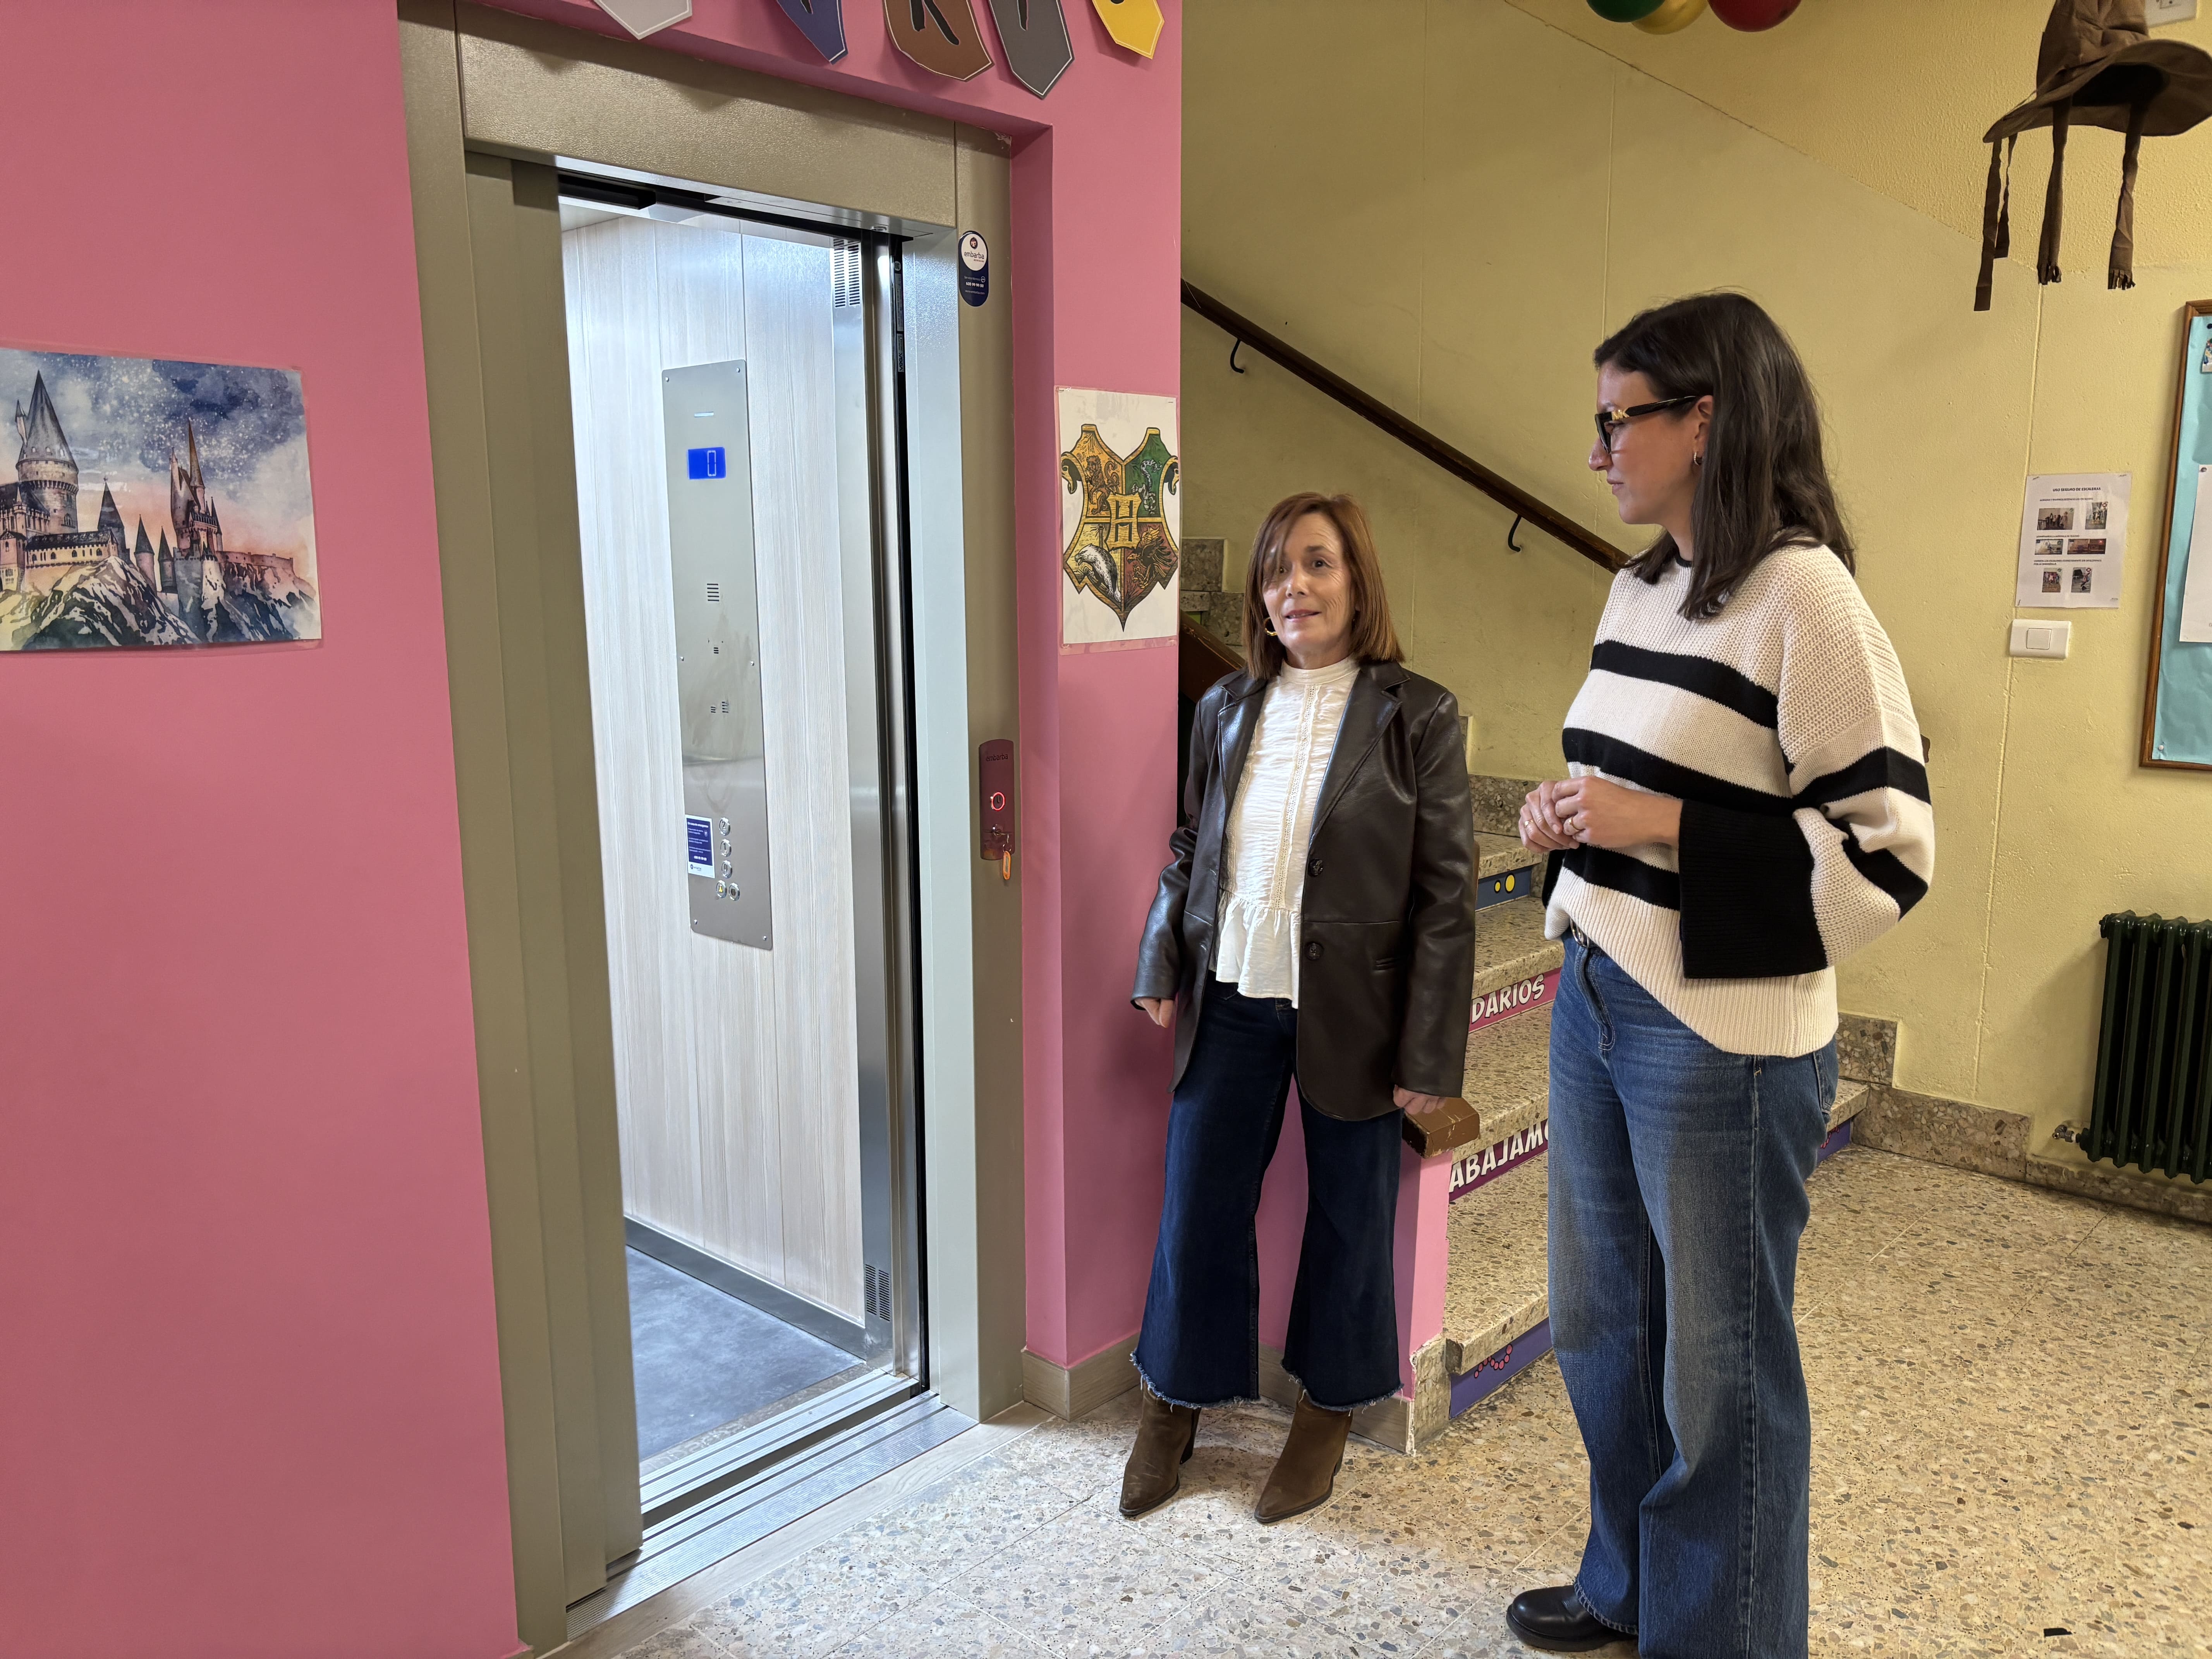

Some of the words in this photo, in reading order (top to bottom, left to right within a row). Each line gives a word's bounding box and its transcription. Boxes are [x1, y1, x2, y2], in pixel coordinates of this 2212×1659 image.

[964, 251, 984, 259] embarba
[707, 450, 716, 476] 0
[1115, 500, 1133, 542] H
[986, 753, 1008, 761] embarba
[1449, 1118, 1548, 1193] ABAJAM
